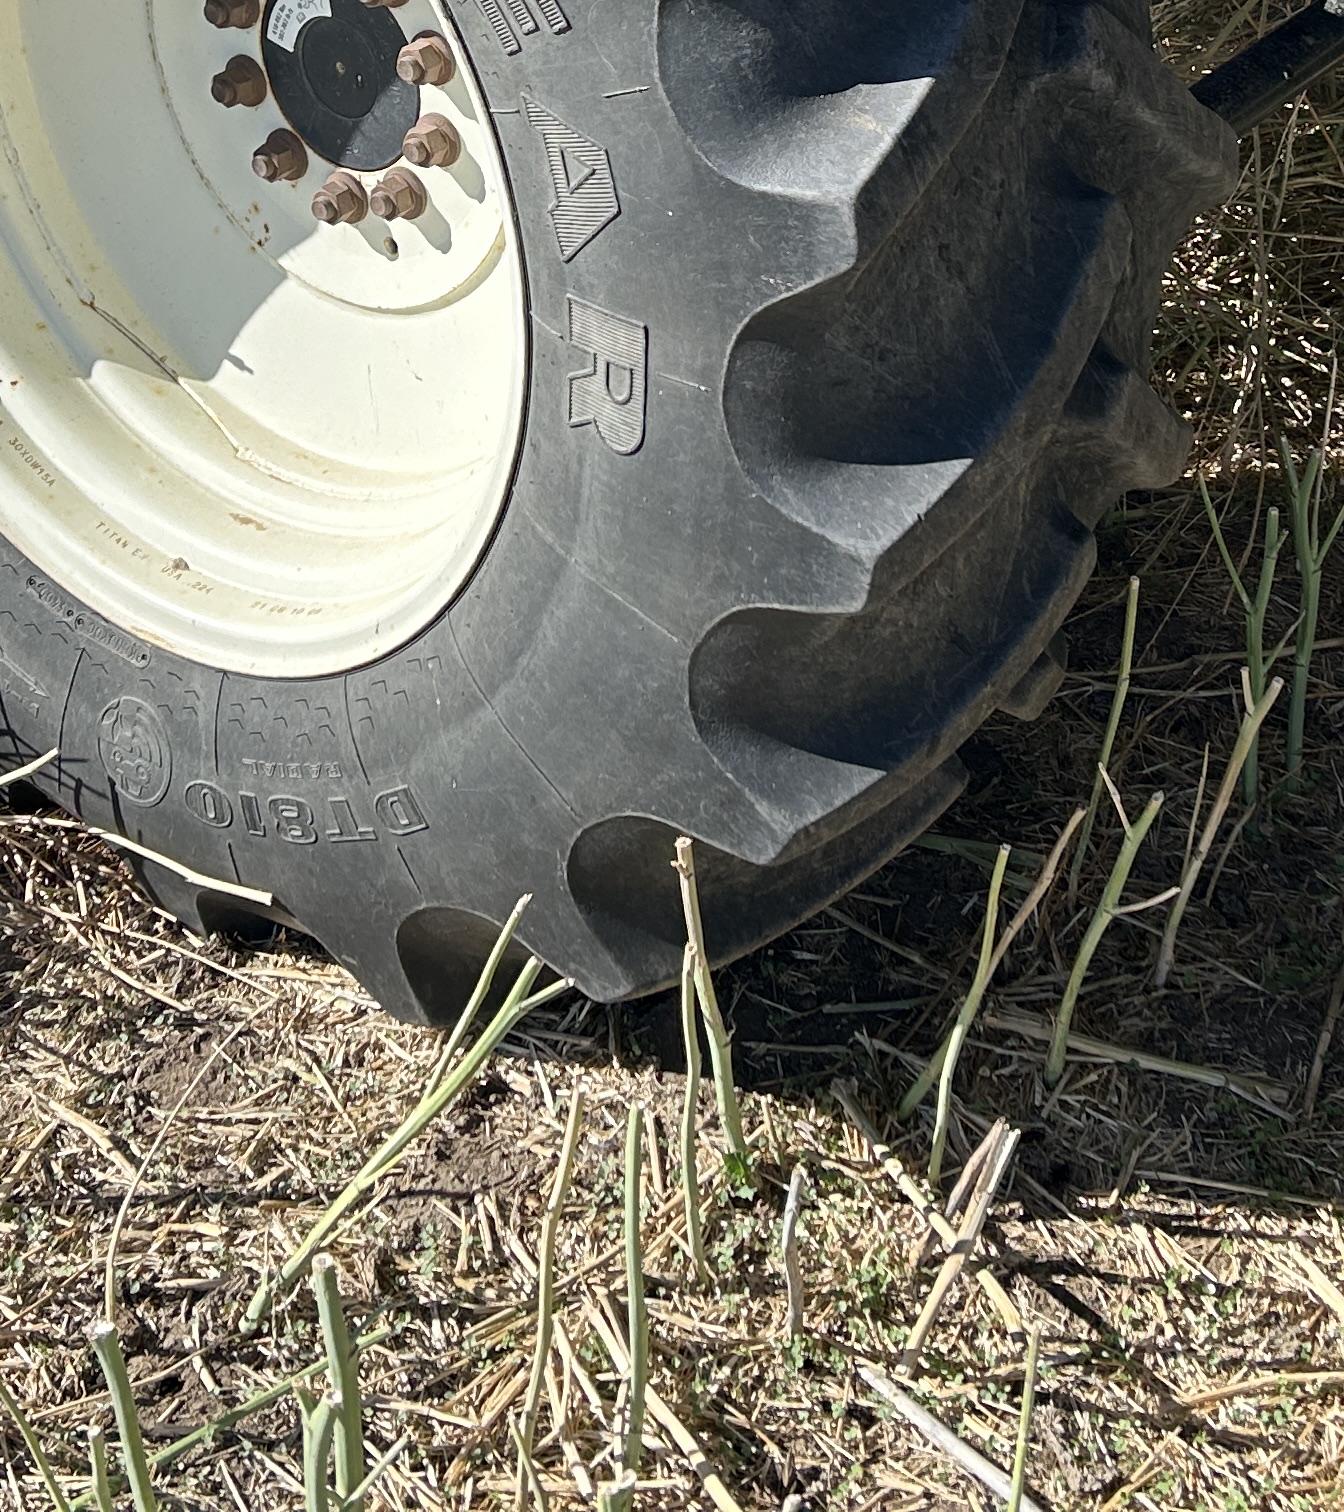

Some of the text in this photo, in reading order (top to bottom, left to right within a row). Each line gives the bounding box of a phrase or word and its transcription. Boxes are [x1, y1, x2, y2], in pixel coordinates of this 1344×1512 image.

[8, 436, 56, 487] 30XDW15A
[96, 521, 128, 549] TITAN
[160, 566, 183, 581] USA
[241, 758, 341, 779] RADIAL
[184, 780, 430, 845] DT810
